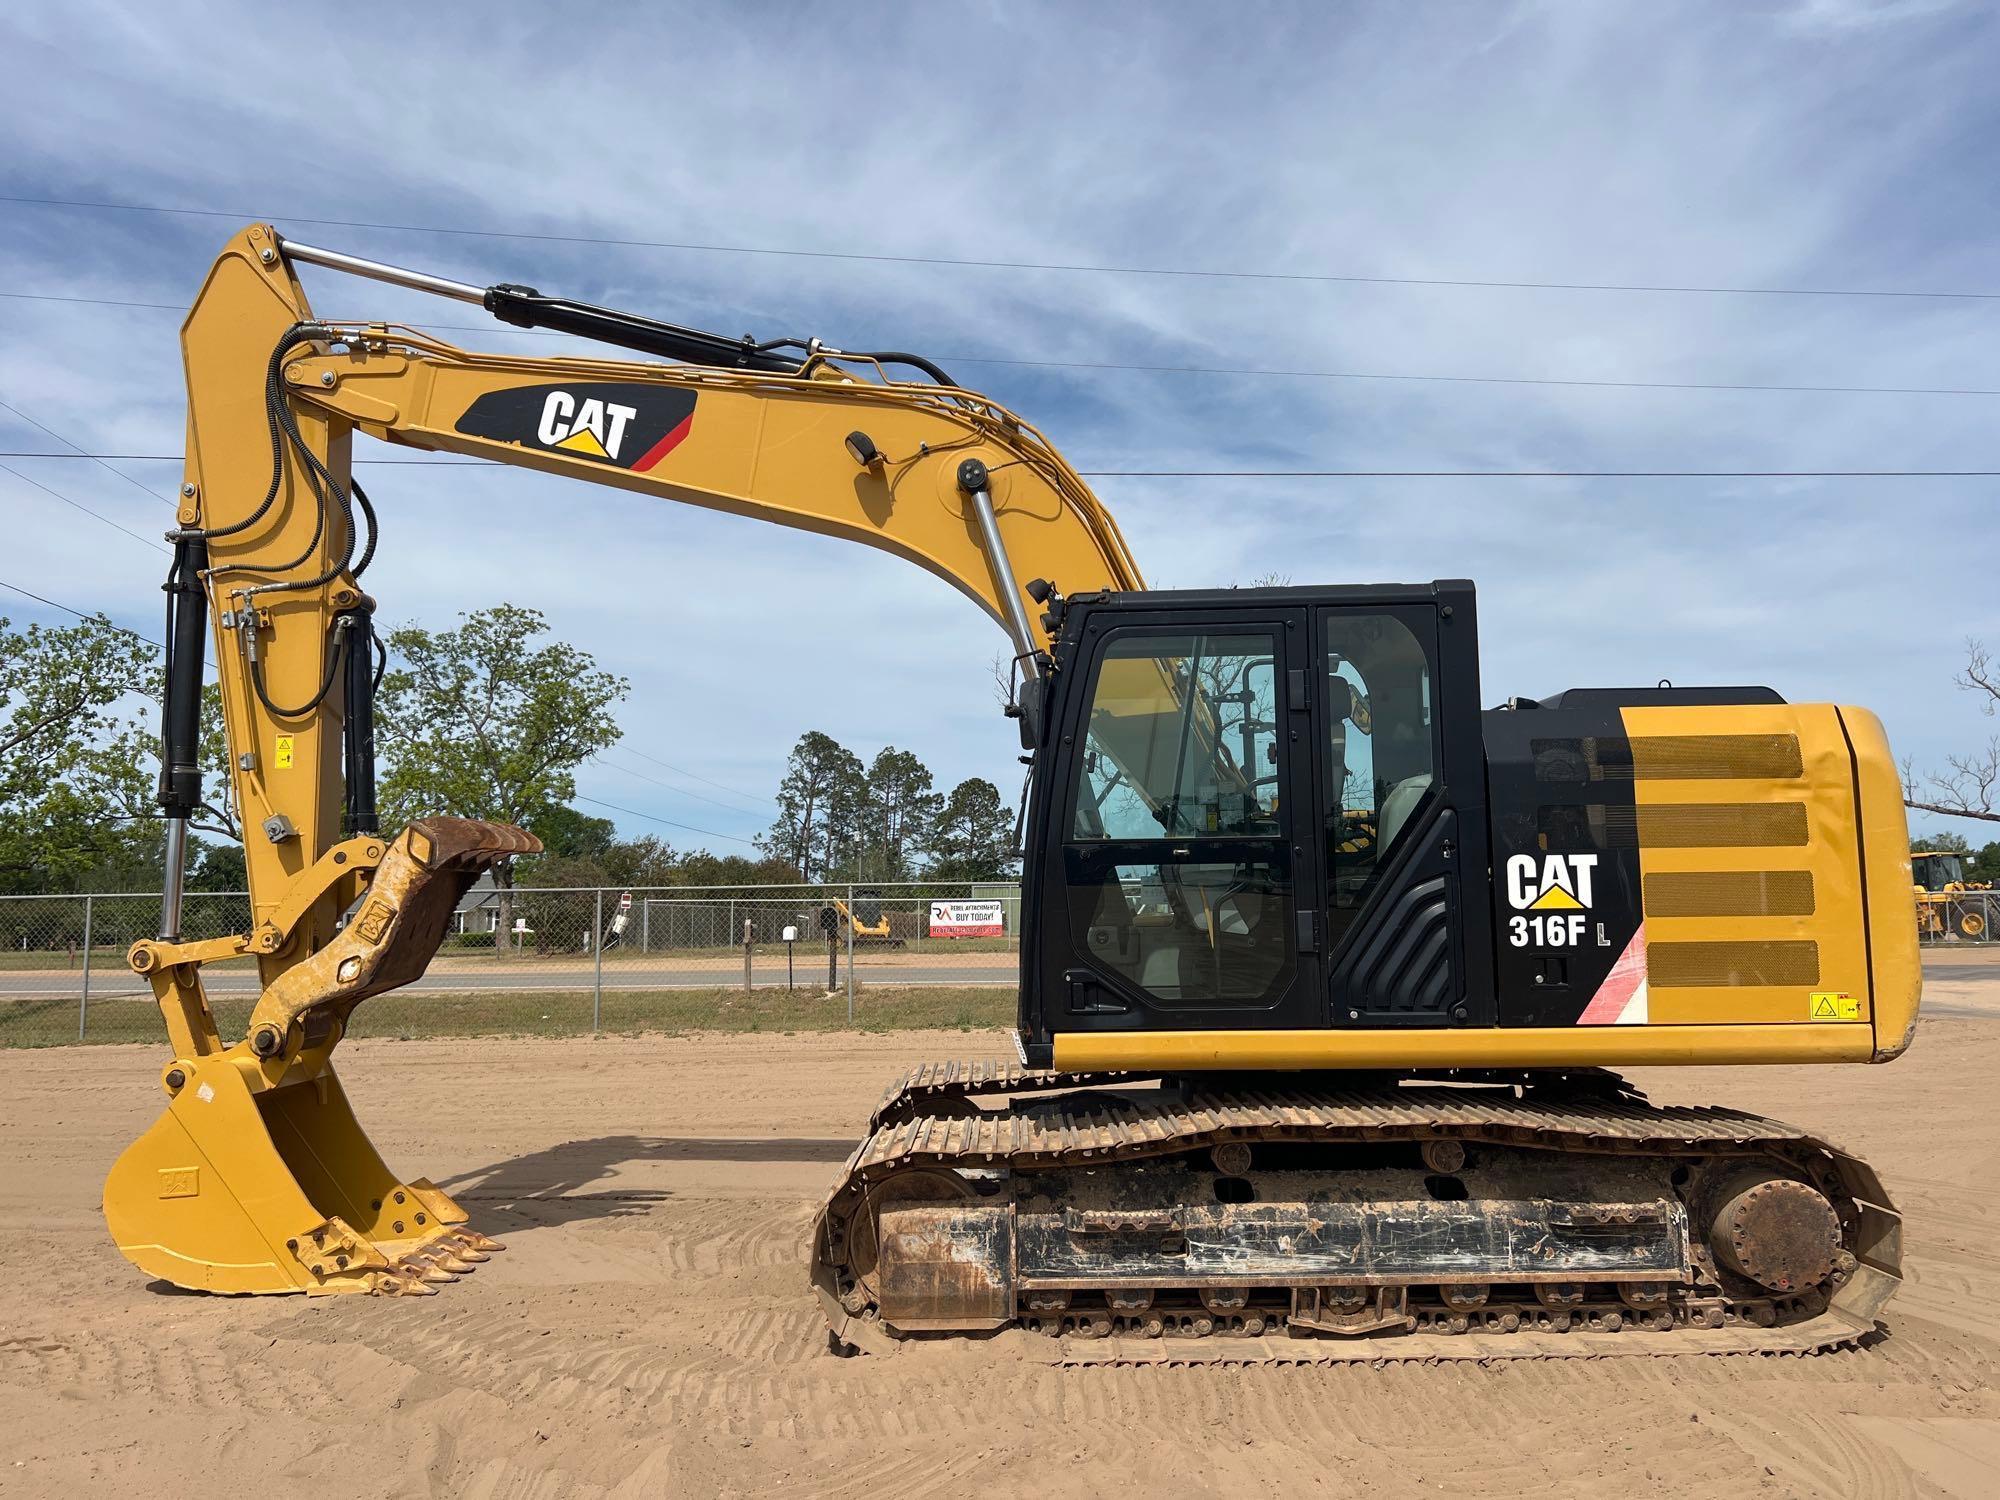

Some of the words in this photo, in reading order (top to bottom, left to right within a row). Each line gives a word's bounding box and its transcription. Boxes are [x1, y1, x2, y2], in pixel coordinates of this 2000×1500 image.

[538, 391, 637, 460] CAT
[1507, 854, 1598, 909] CAT
[956, 913, 969, 921] BUY
[971, 913, 994, 921] TODAY!
[1509, 915, 1586, 947] 316F
[1597, 922, 1611, 946] L
